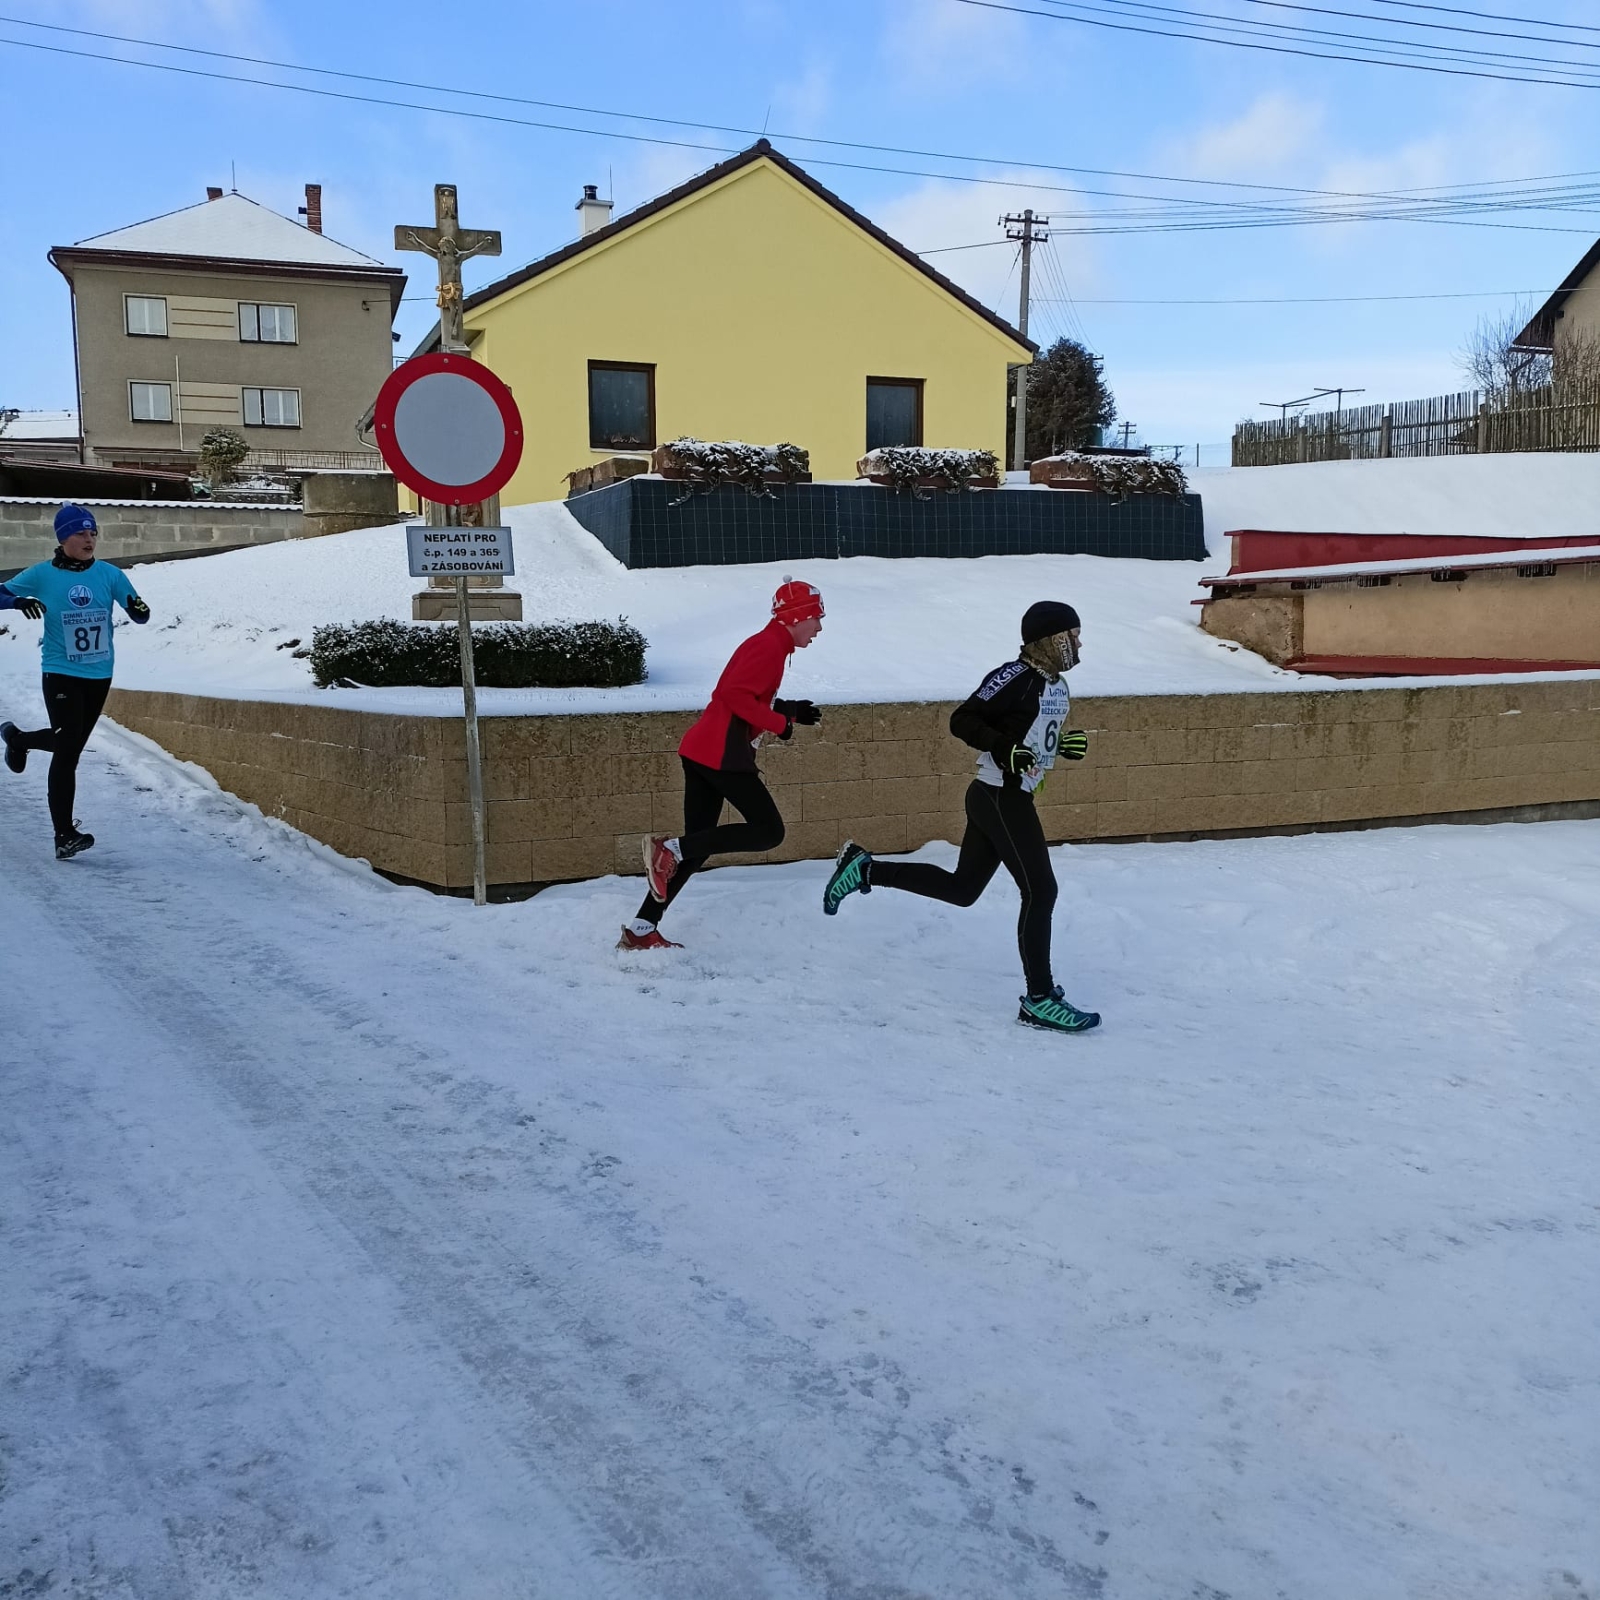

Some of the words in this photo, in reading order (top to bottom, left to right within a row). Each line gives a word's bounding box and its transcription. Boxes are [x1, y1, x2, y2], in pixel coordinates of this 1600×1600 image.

[424, 532, 471, 542] NEPLATÍ
[475, 534, 496, 542] PRO
[424, 549, 444, 558] č.p.
[479, 548, 500, 556] 365
[421, 563, 428, 571] a
[431, 560, 504, 571] ZÁSOBOVÁNÍ
[74, 626, 101, 652] 87
[1044, 720, 1063, 752] 6
